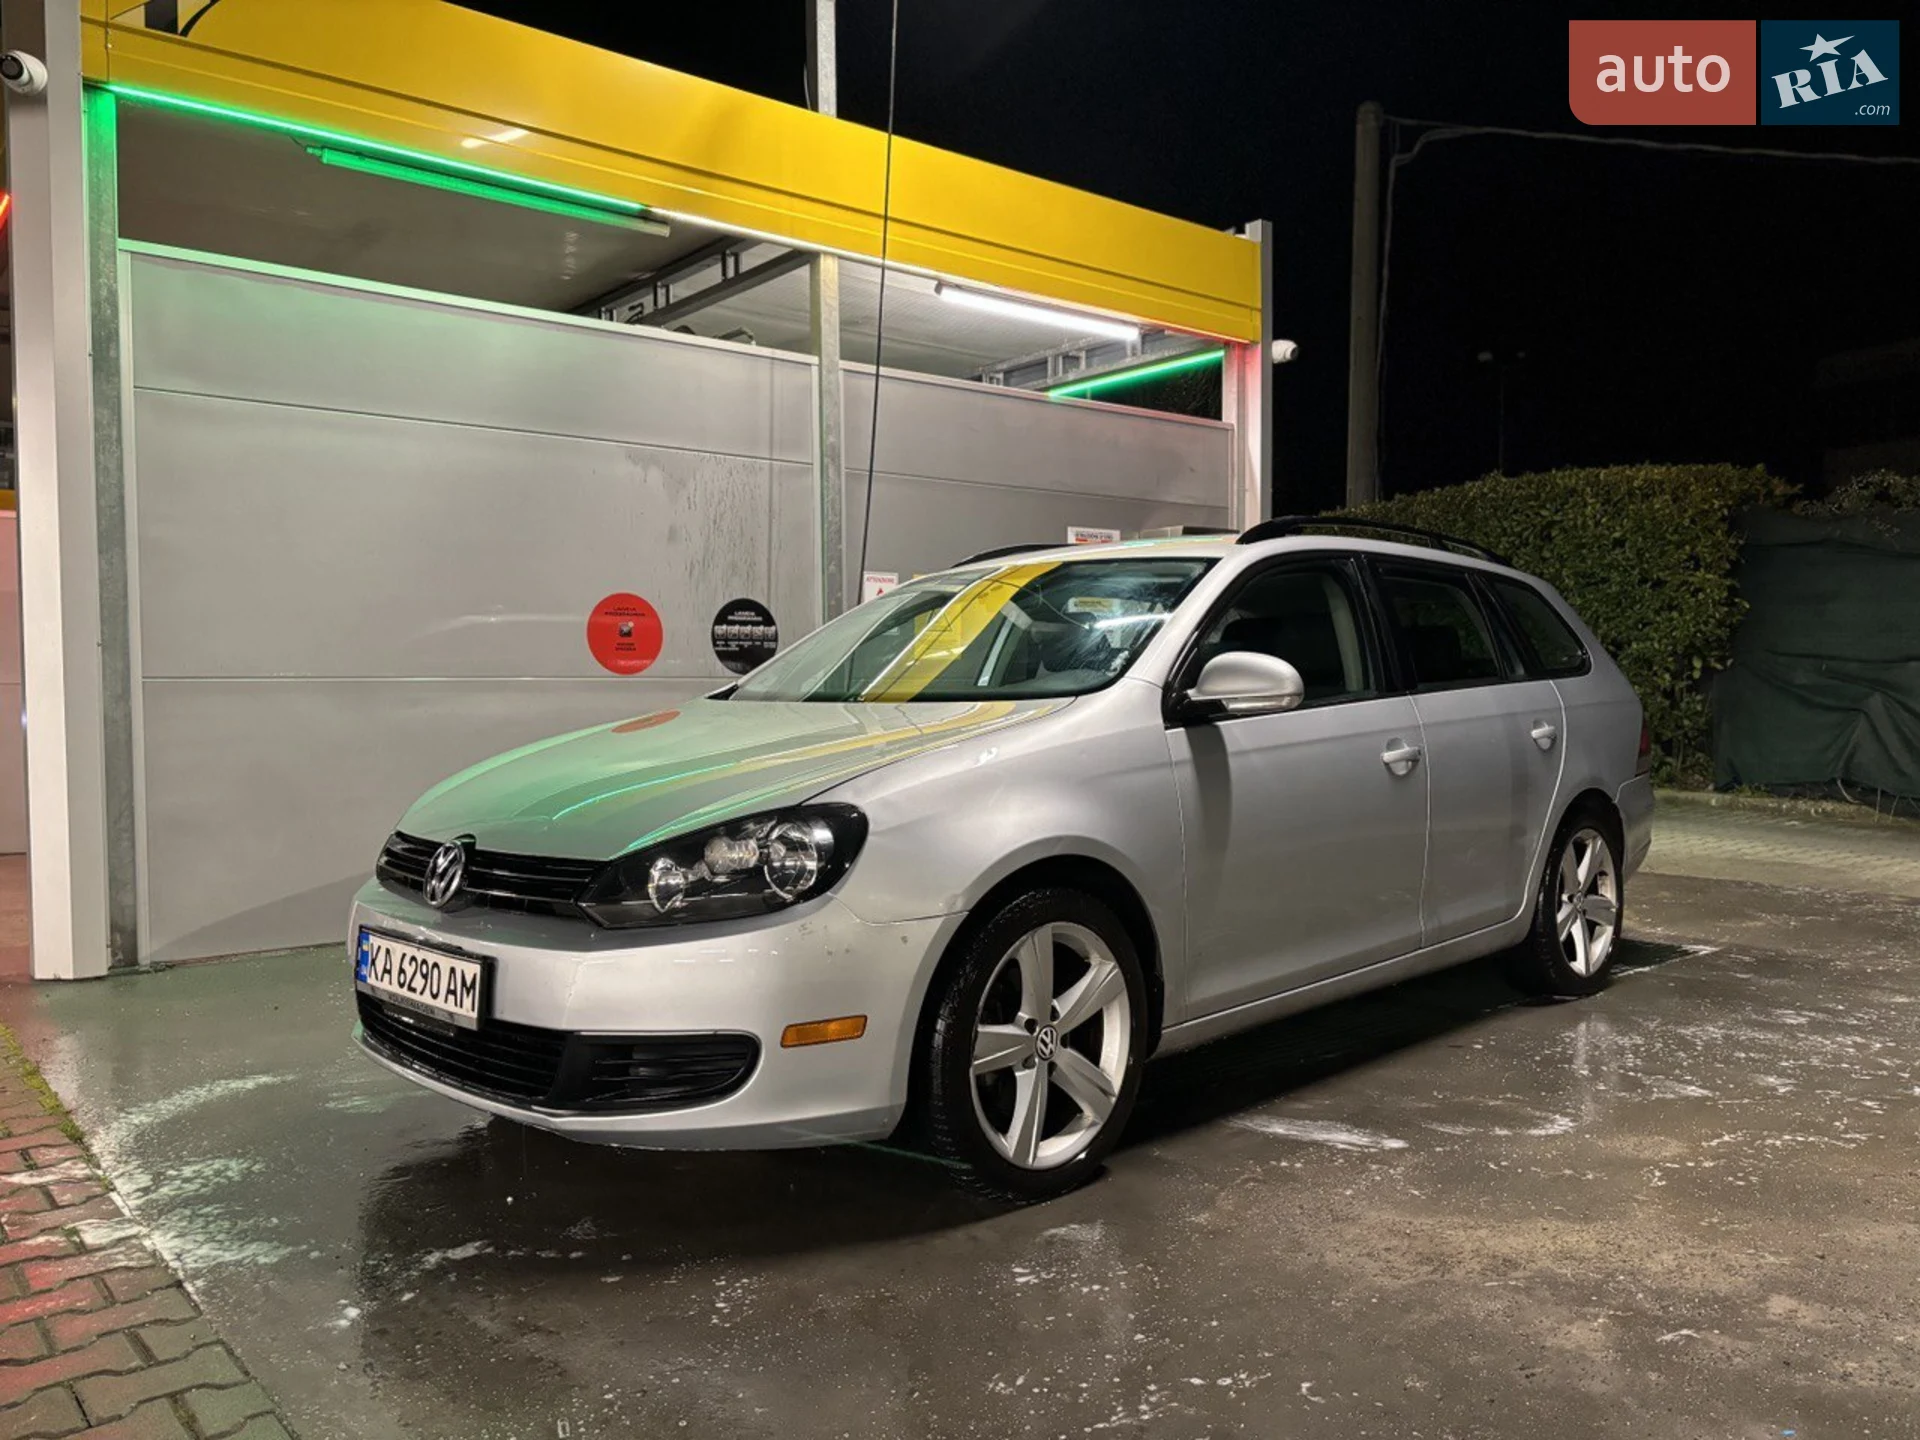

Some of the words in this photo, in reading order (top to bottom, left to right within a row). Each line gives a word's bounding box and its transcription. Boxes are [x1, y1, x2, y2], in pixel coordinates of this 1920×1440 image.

[368, 943, 393, 986] KA
[397, 952, 441, 1000] 6290
[444, 966, 477, 1013] AM
